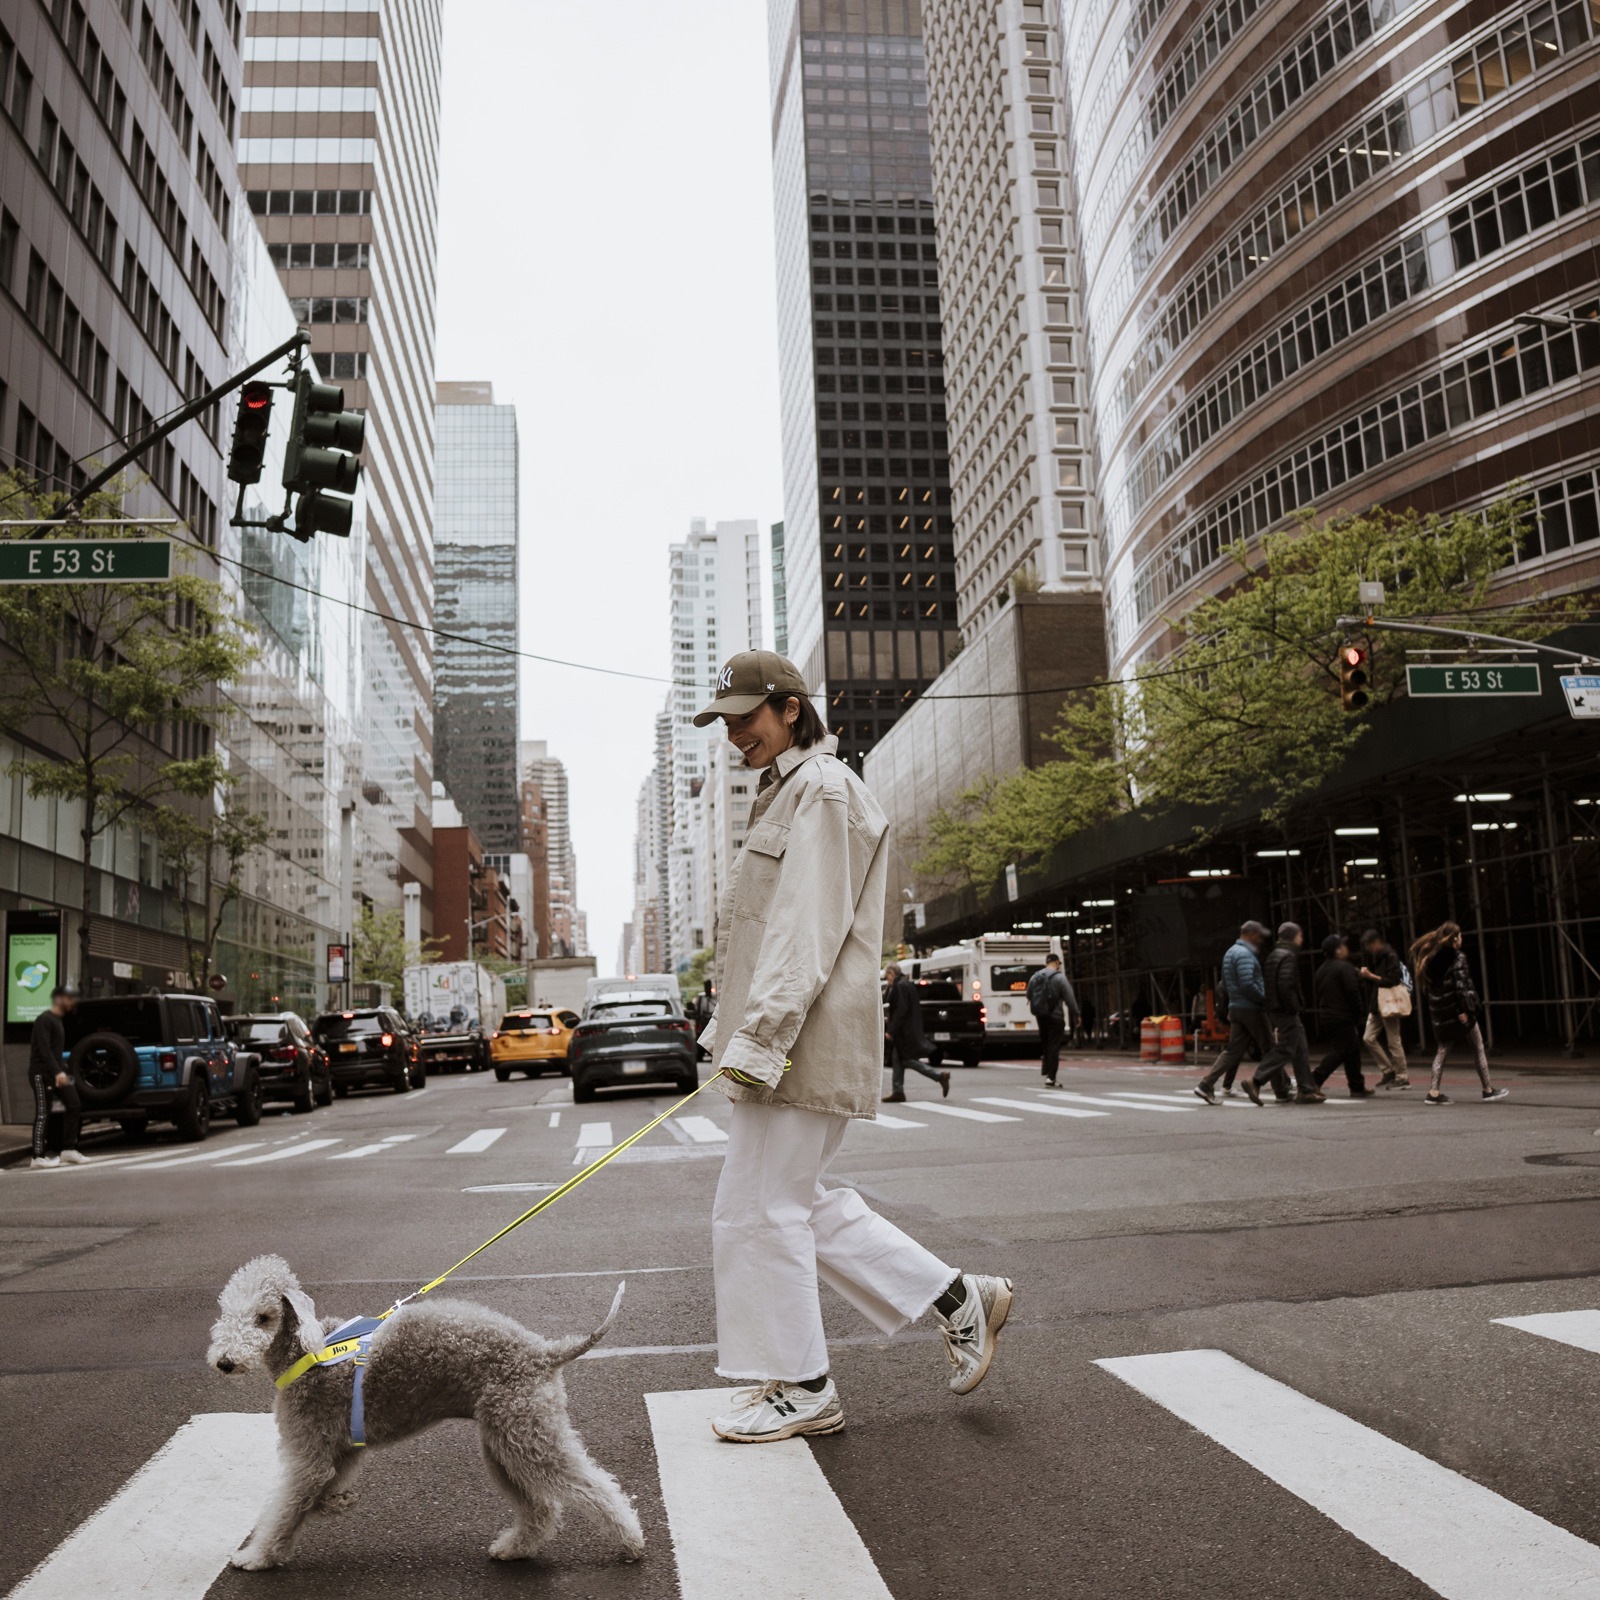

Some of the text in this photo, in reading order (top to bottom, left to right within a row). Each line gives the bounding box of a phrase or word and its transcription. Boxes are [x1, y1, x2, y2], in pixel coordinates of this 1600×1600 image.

[28, 549, 115, 573] E 53 St
[1444, 670, 1503, 690] E 53 St
[1579, 678, 1597, 688] BUS
